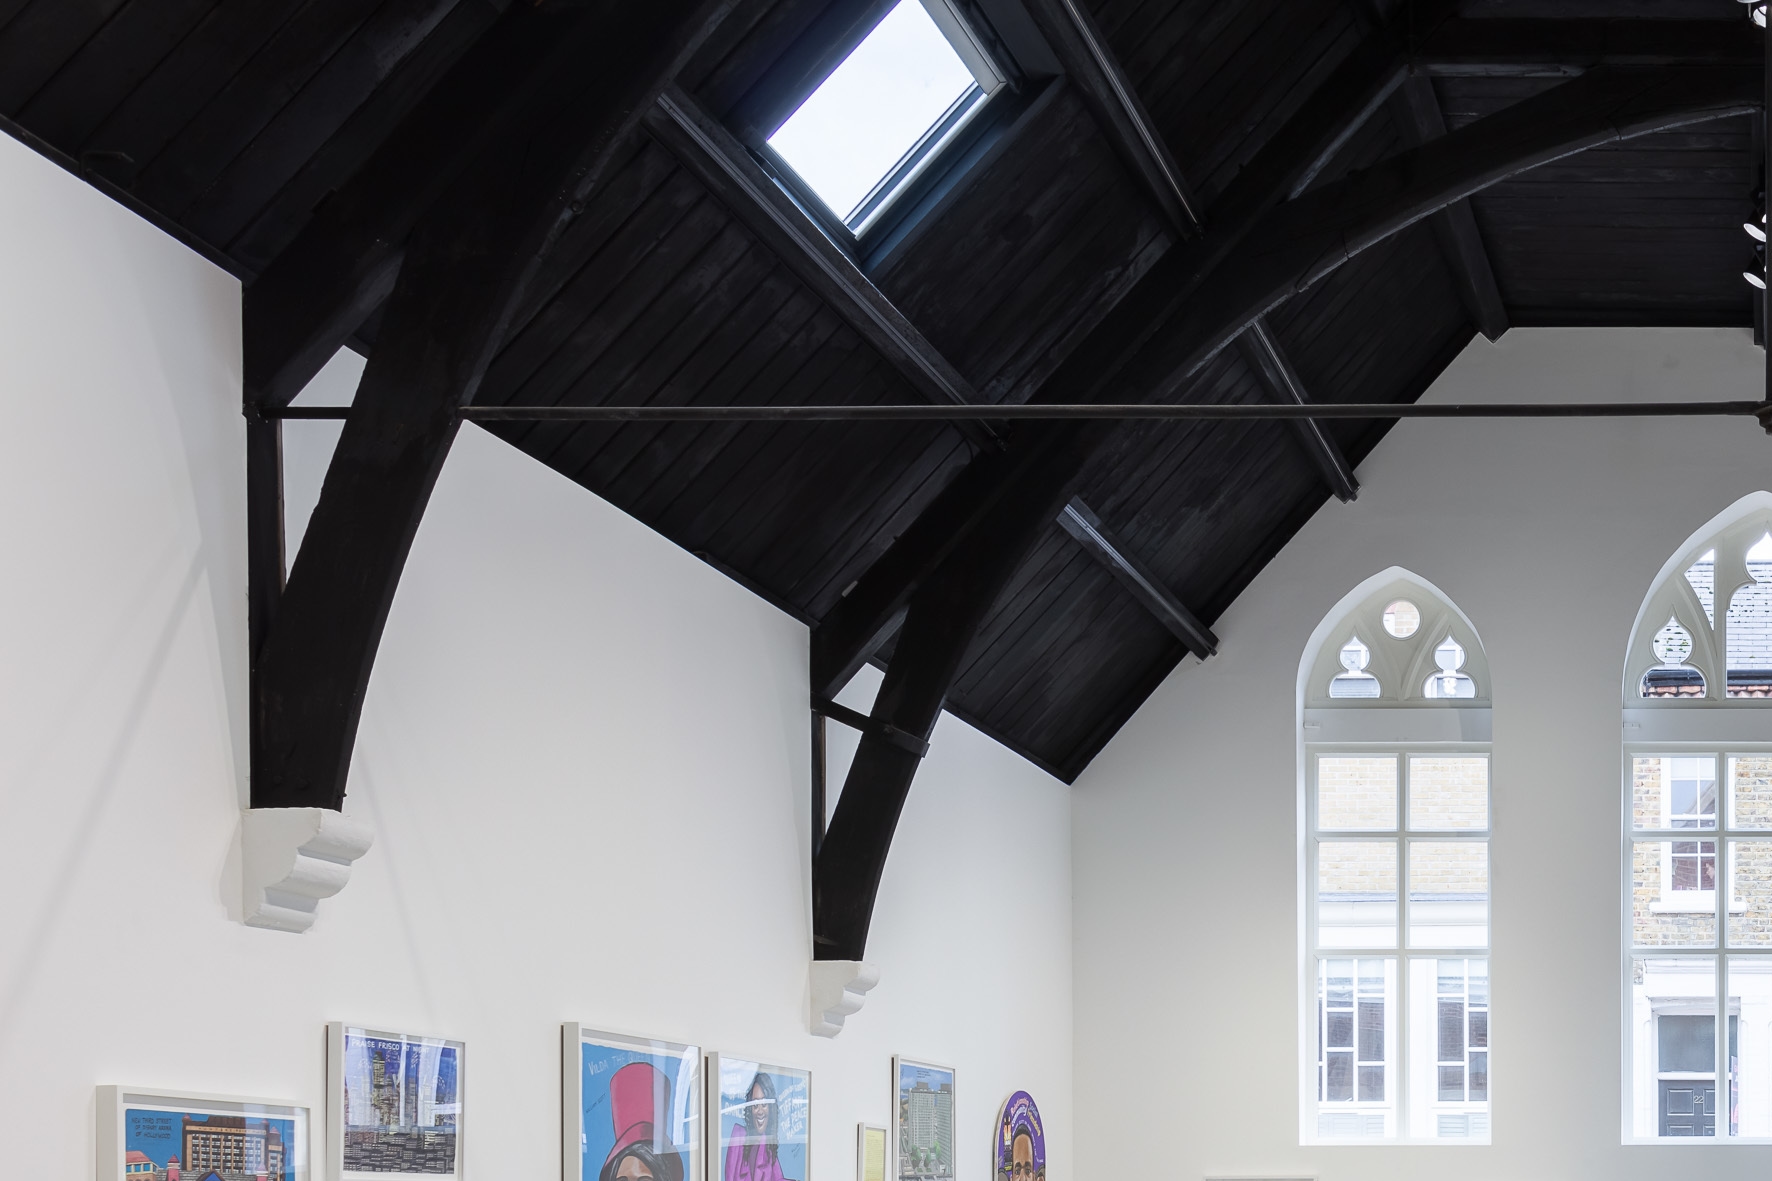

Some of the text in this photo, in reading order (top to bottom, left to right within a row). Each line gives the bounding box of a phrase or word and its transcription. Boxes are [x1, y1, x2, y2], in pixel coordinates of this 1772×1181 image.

[378, 1041, 400, 1051] FRISCO
[587, 1060, 608, 1076] VILDA
[1693, 1095, 1704, 1104] 22
